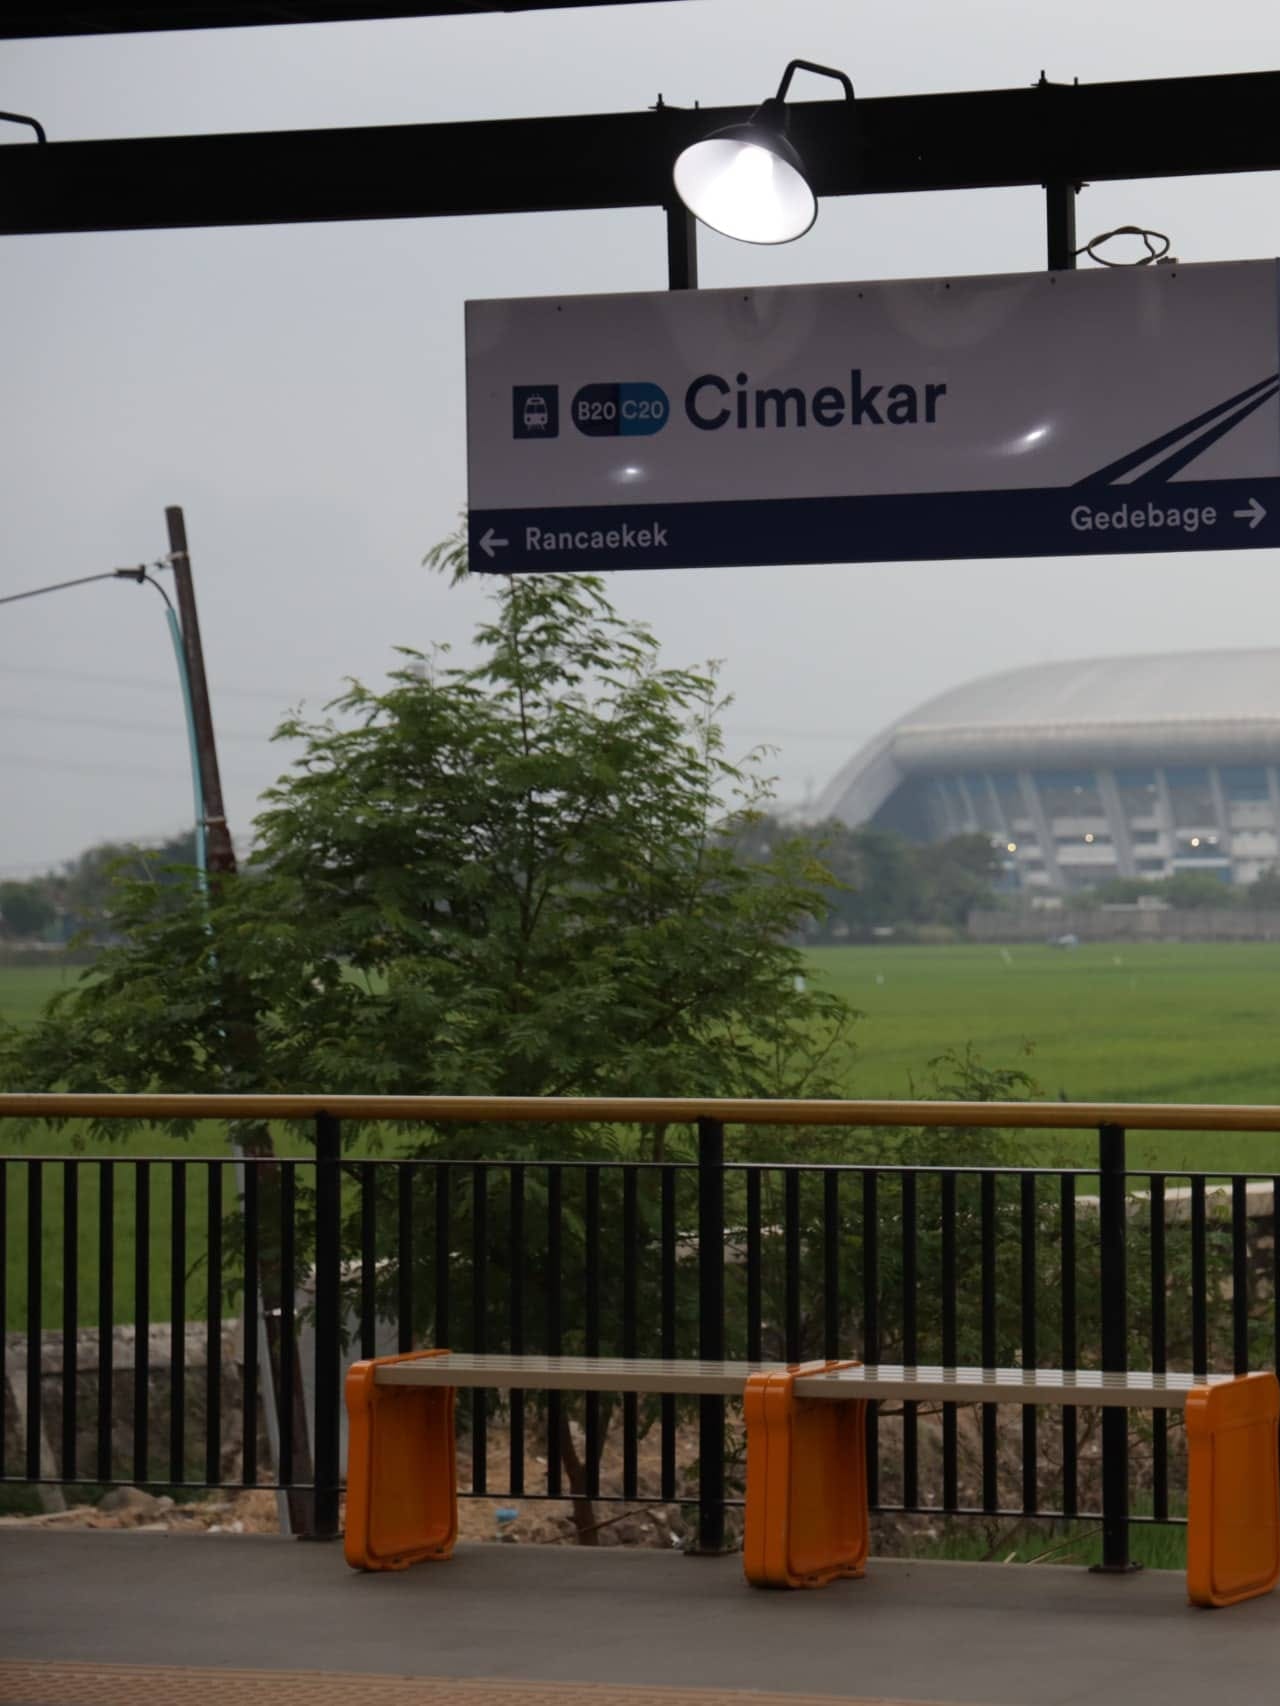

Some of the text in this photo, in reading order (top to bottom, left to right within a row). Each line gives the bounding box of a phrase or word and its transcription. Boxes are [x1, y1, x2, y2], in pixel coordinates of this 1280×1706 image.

[578, 369, 947, 431] B20 C20 Cimekar
[1071, 502, 1217, 532] Gedebage
[526, 522, 668, 550] Rancaekek
